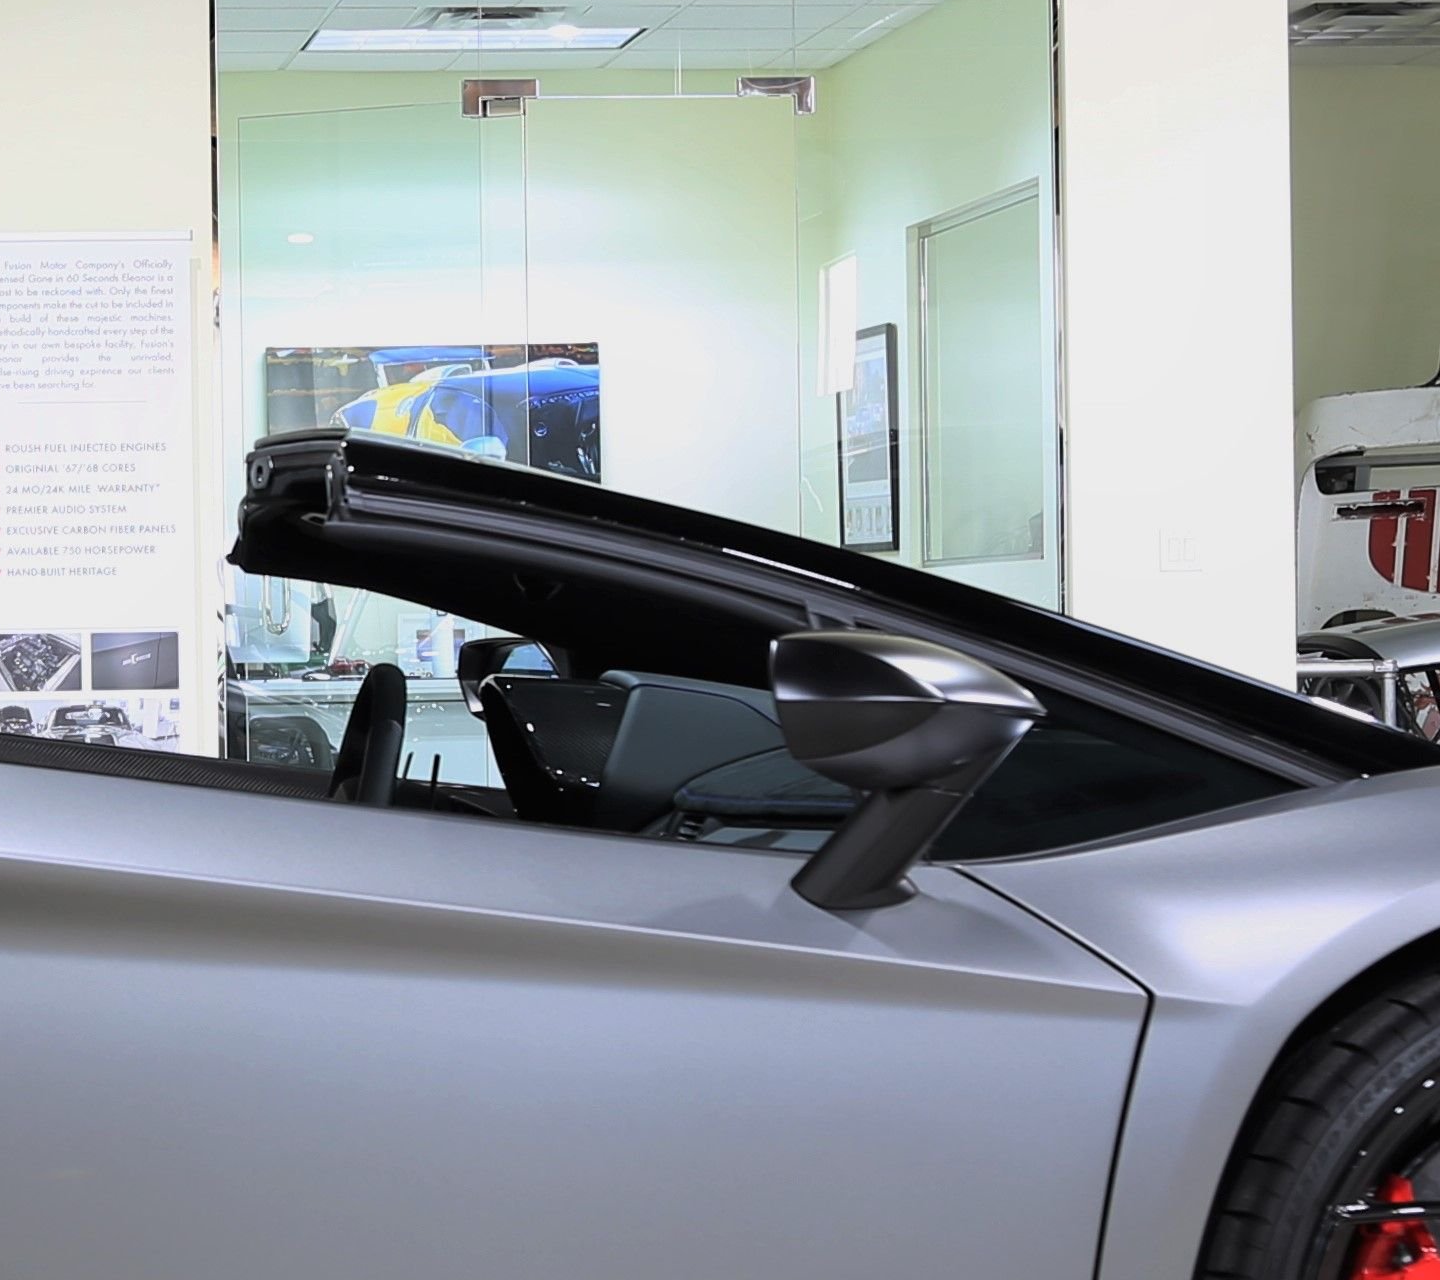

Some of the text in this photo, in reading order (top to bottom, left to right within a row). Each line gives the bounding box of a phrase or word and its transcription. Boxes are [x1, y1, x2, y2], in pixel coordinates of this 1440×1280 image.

[4, 260, 173, 272] Fusion Motor Company's Officially
[28, 274, 53, 283] Gone
[66, 274, 80, 282] 60
[82, 273, 119, 282] Seconds
[122, 273, 155, 282] Eleanor
[26, 287, 38, 296] be
[42, 287, 82, 296] reckoned
[109, 286, 131, 298] Only
[134, 286, 148, 295] the
[150, 286, 174, 295] finest
[43, 301, 67, 309] make
[69, 300, 82, 309] the
[85, 300, 98, 309] cut
[111, 300, 123, 309] be
[125, 299, 163, 309] included
[9, 314, 32, 323] build
[56, 313, 80, 322] these
[87, 313, 123, 325] majestic
[47, 327, 101, 336] handcrafted
[103, 329, 127, 338] every
[129, 326, 148, 338] step
[161, 326, 174, 335] the
[64, 340, 101, 352] bespoke
[42, 353, 80, 365] provides
[98, 353, 111, 362] the
[44, 367, 75, 378] driving
[147, 366, 175, 375] clients
[13, 380, 35, 389] been
[37, 380, 80, 392] searching
[5, 442, 167, 453] ROUSH FUEL INJECTED ENGINES
[102, 463, 136, 473] CORES
[5, 485, 18, 495] 24
[68, 484, 91, 494] MILE
[6, 504, 127, 514] PREMIER AUDIO SYSTEM
[6, 525, 176, 536] EXCLUSIVE CARBON FIBER PANELS
[7, 545, 156, 556] AVAILABLE 750 HORSEPOWER
[69, 567, 117, 576] HERITAGE
